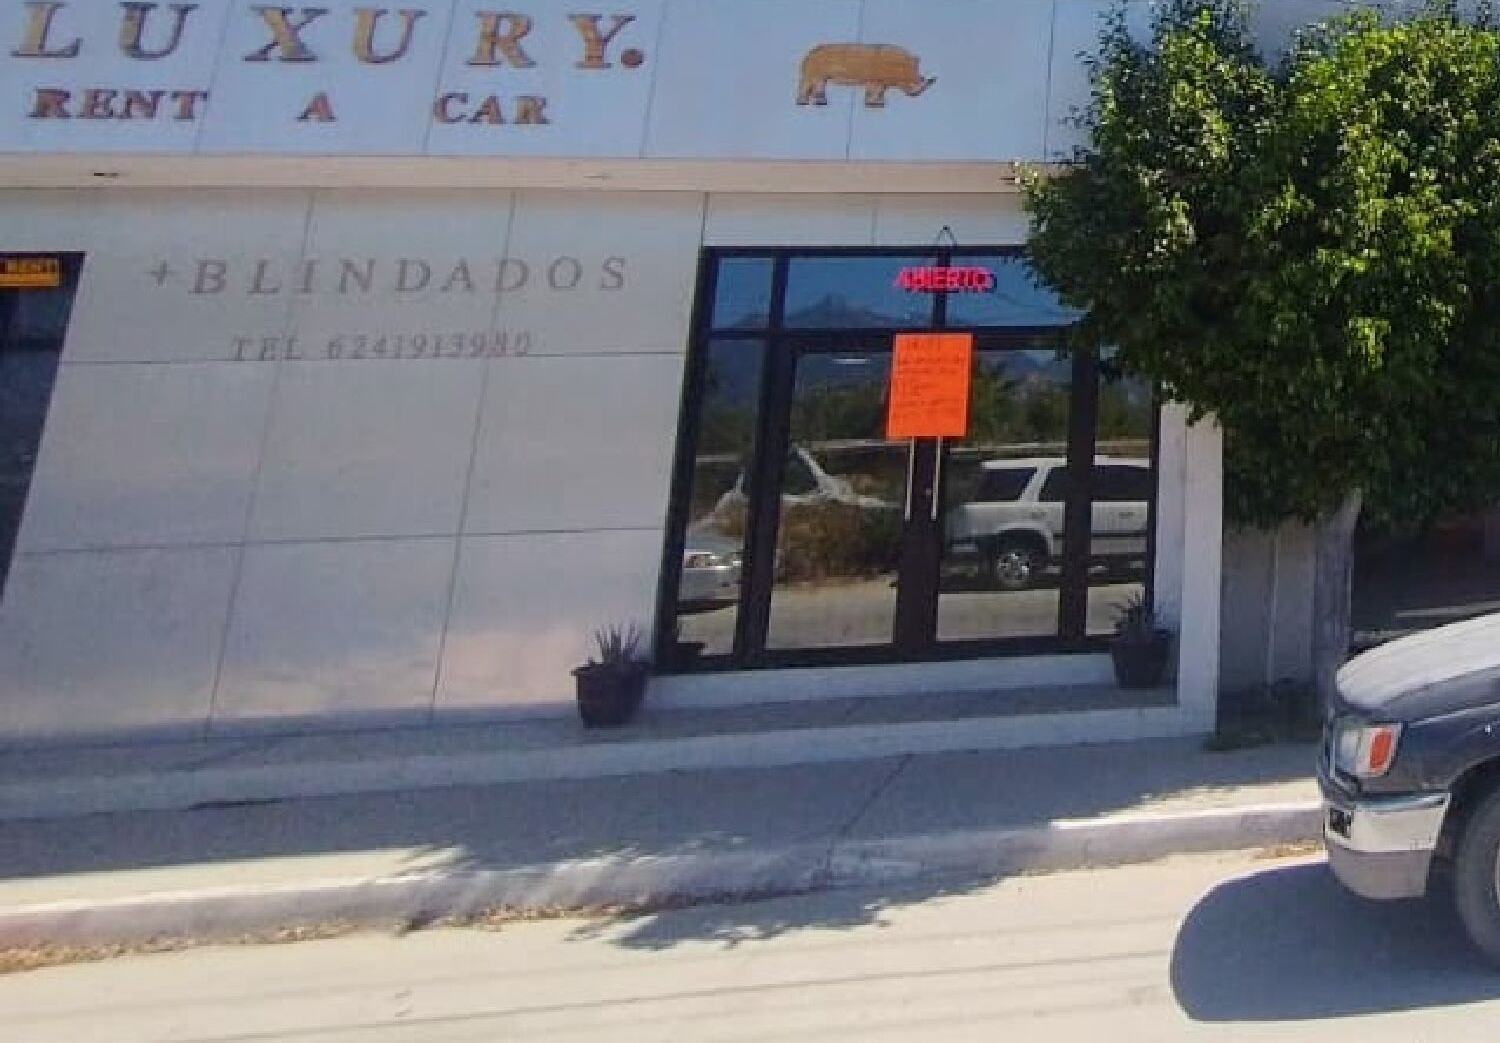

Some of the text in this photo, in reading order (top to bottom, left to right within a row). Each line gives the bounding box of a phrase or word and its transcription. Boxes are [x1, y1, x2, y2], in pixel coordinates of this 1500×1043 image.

[27, 88, 550, 125] RENT A CAR
[893, 266, 994, 289] ABIERTO
[230, 331, 302, 361] TEL
